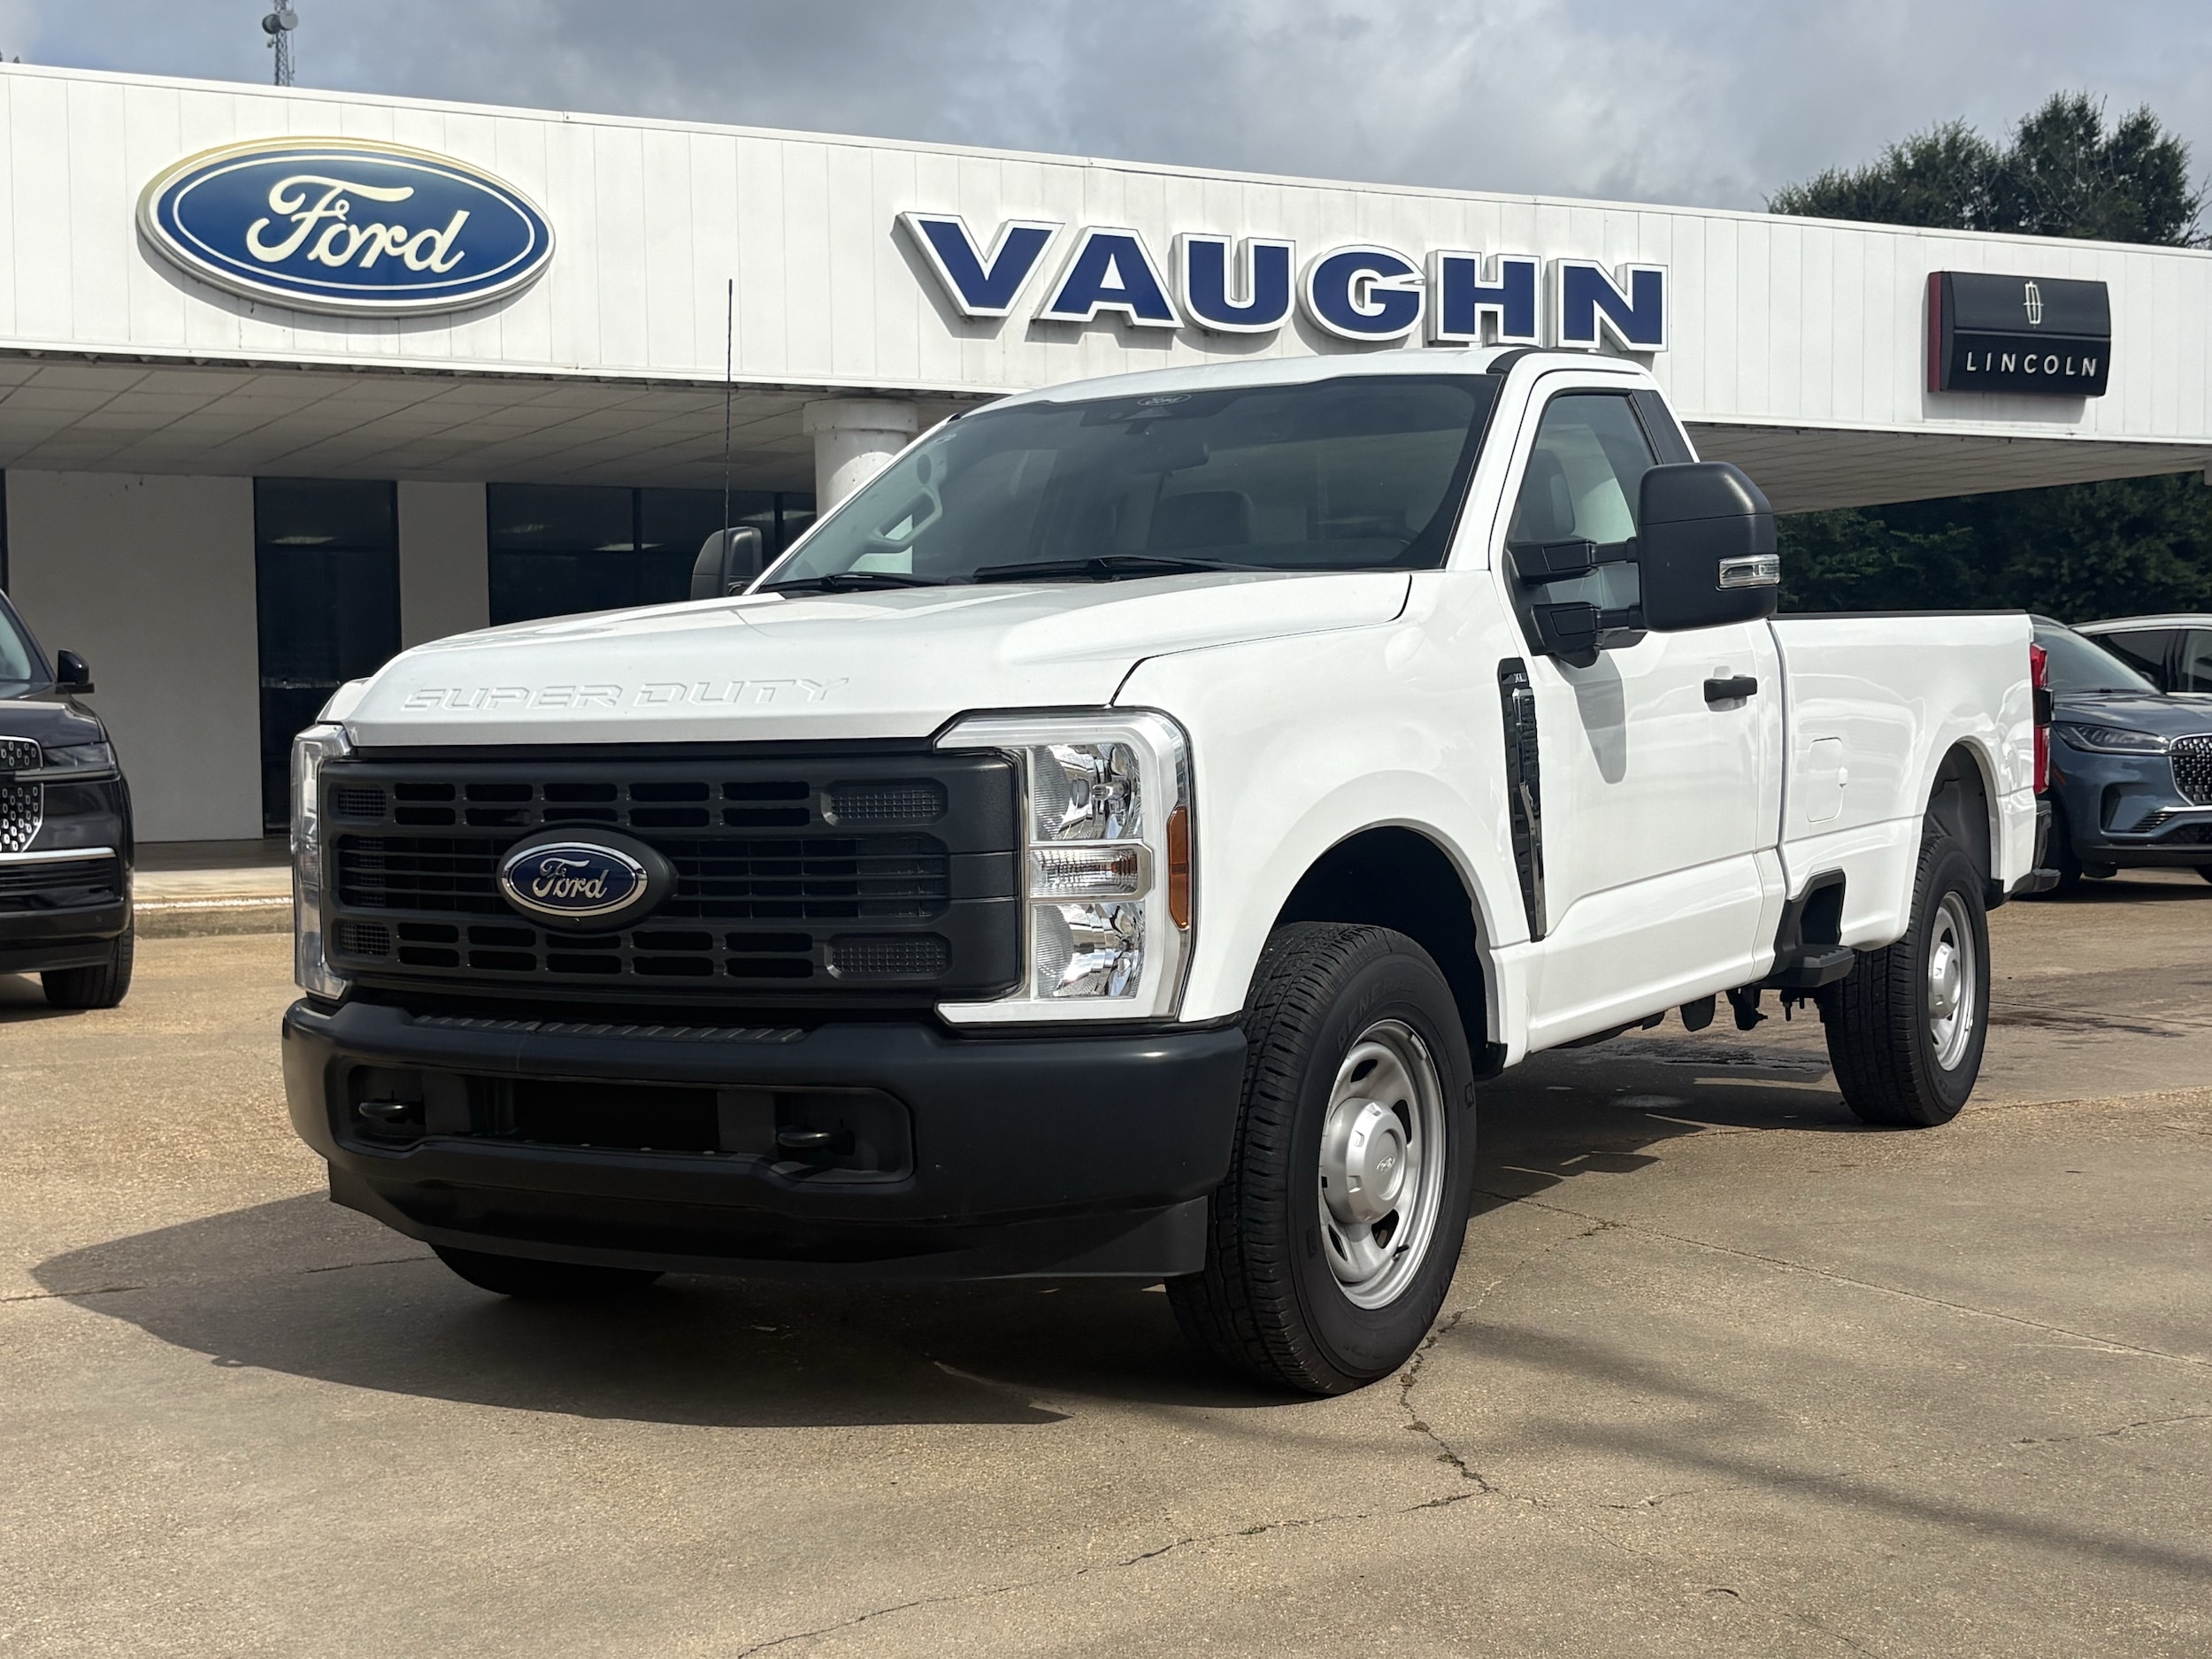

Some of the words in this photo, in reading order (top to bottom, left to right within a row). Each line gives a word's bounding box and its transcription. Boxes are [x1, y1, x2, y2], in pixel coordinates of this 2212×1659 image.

[246, 174, 470, 273] Ford
[894, 211, 1669, 352] VAUGHN
[1966, 351, 2098, 377] LINCOLN
[401, 684, 623, 711] SUPER
[632, 677, 849, 709] DUTY
[1513, 672, 1526, 684] XL
[532, 857, 610, 899] Ford
